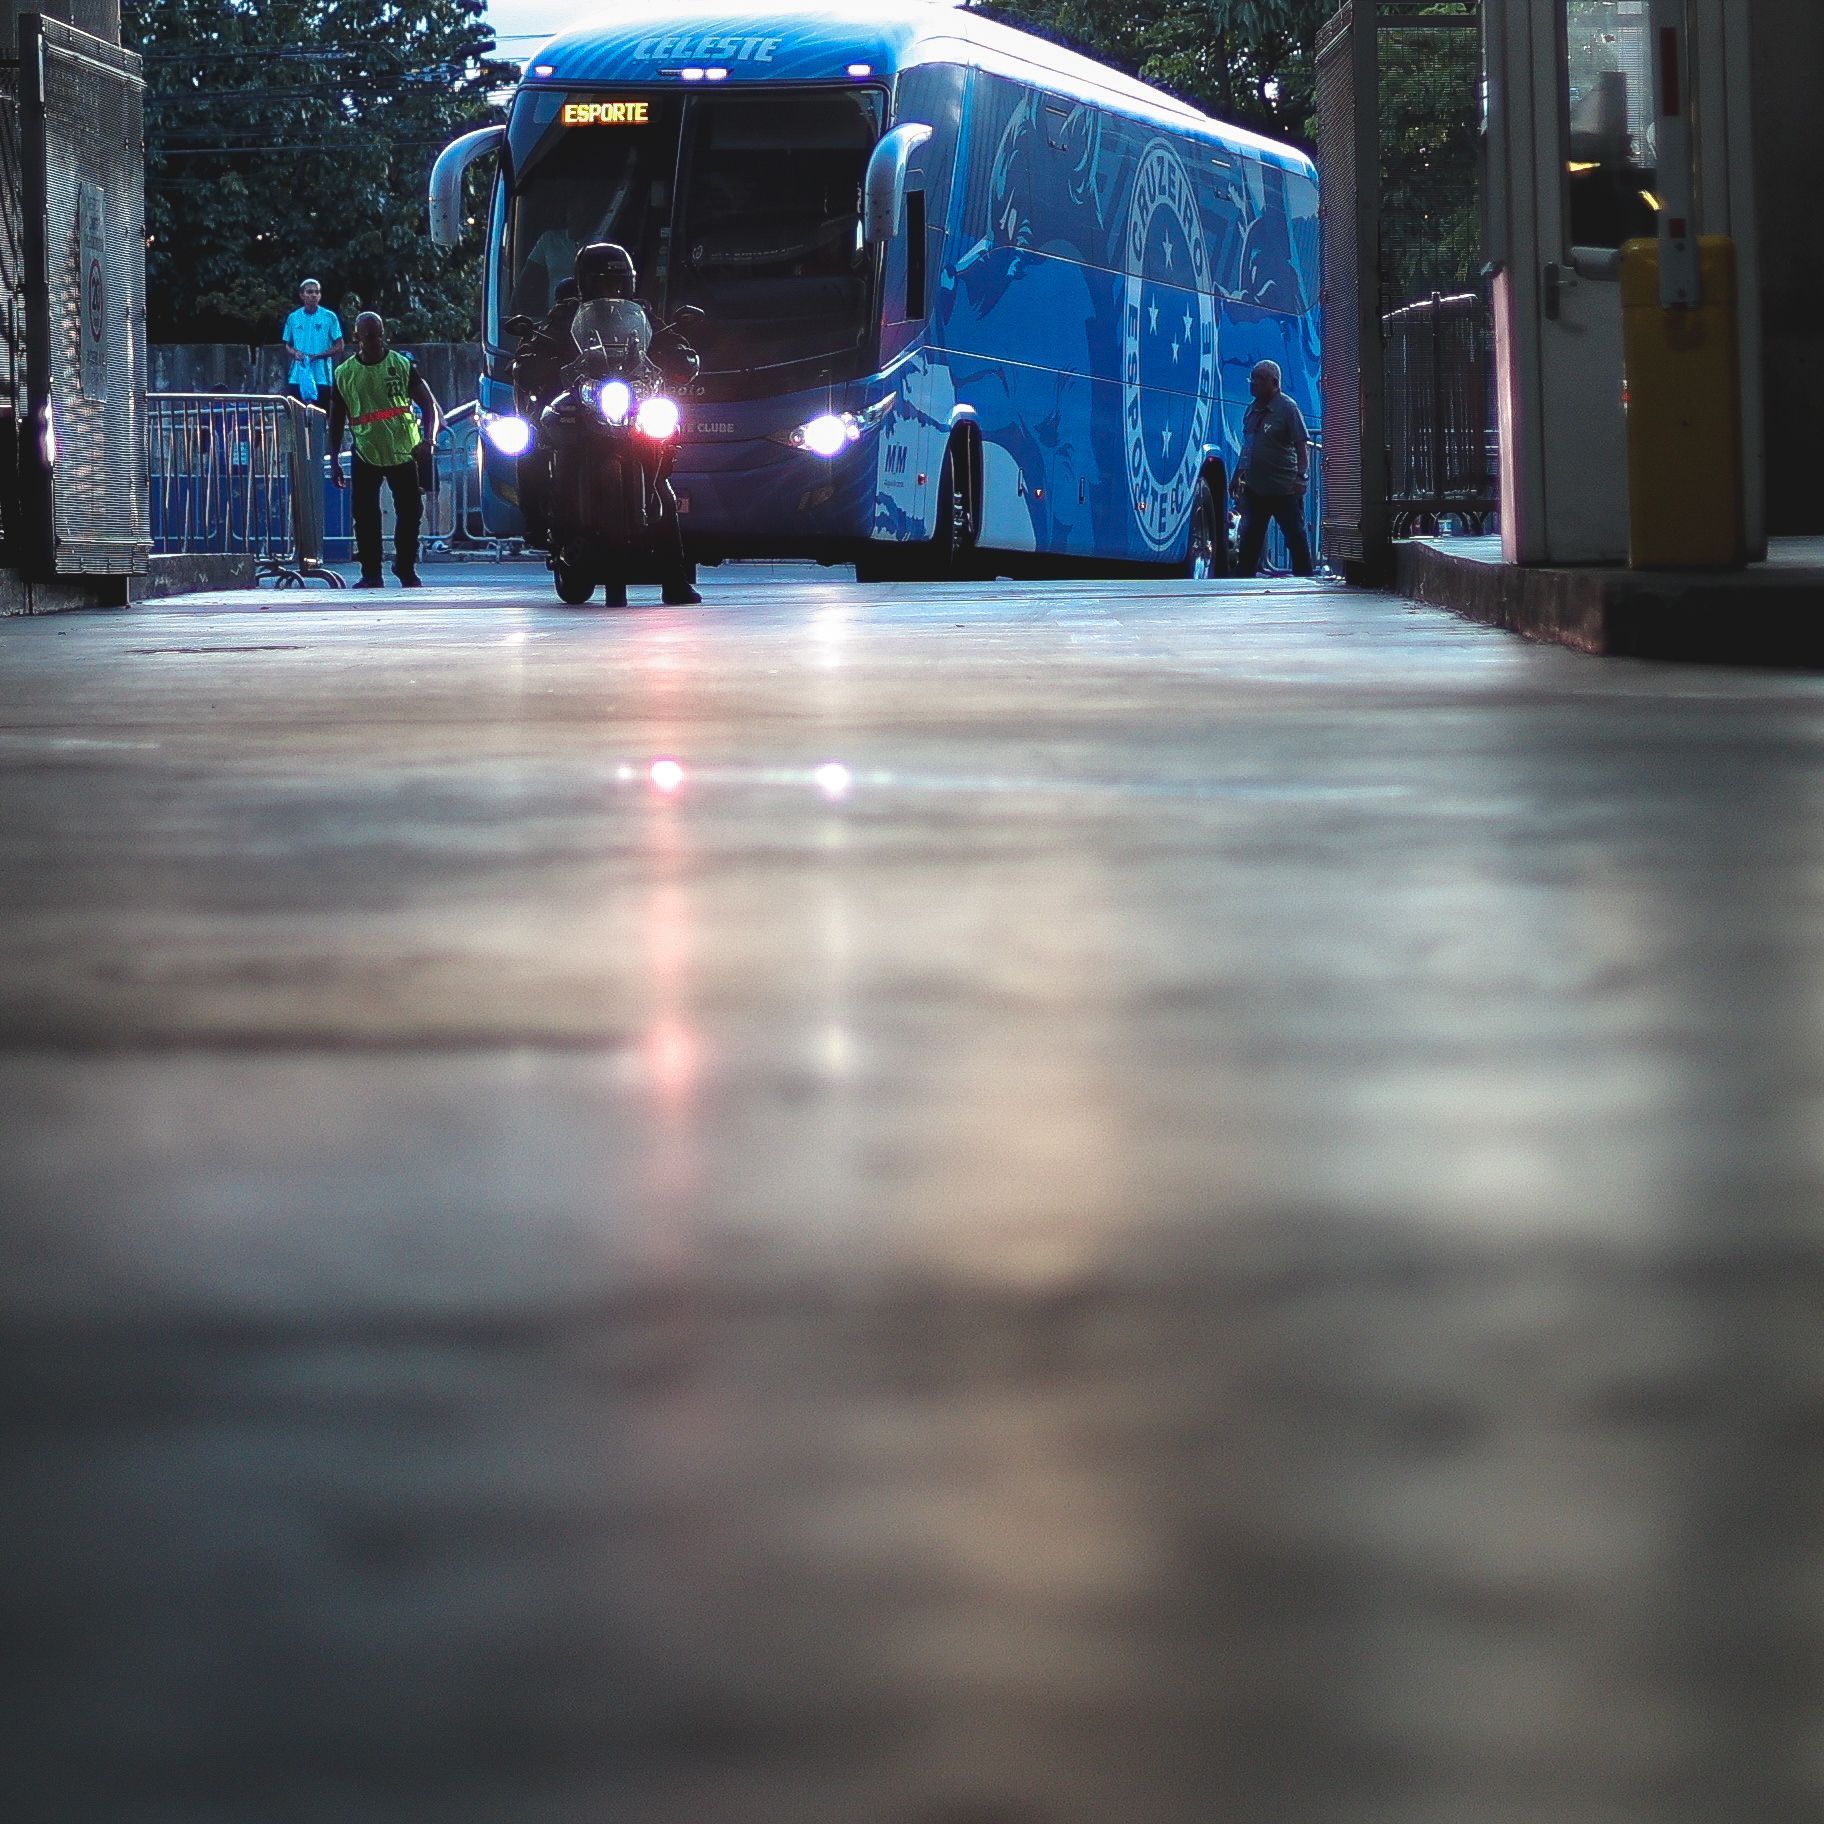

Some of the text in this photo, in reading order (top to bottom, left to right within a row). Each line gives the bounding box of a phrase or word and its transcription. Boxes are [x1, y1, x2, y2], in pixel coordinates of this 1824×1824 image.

[633, 37, 782, 62] CELESTE
[563, 102, 649, 123] ESPORTE
[1132, 155, 1202, 277] CRUZEIRO
